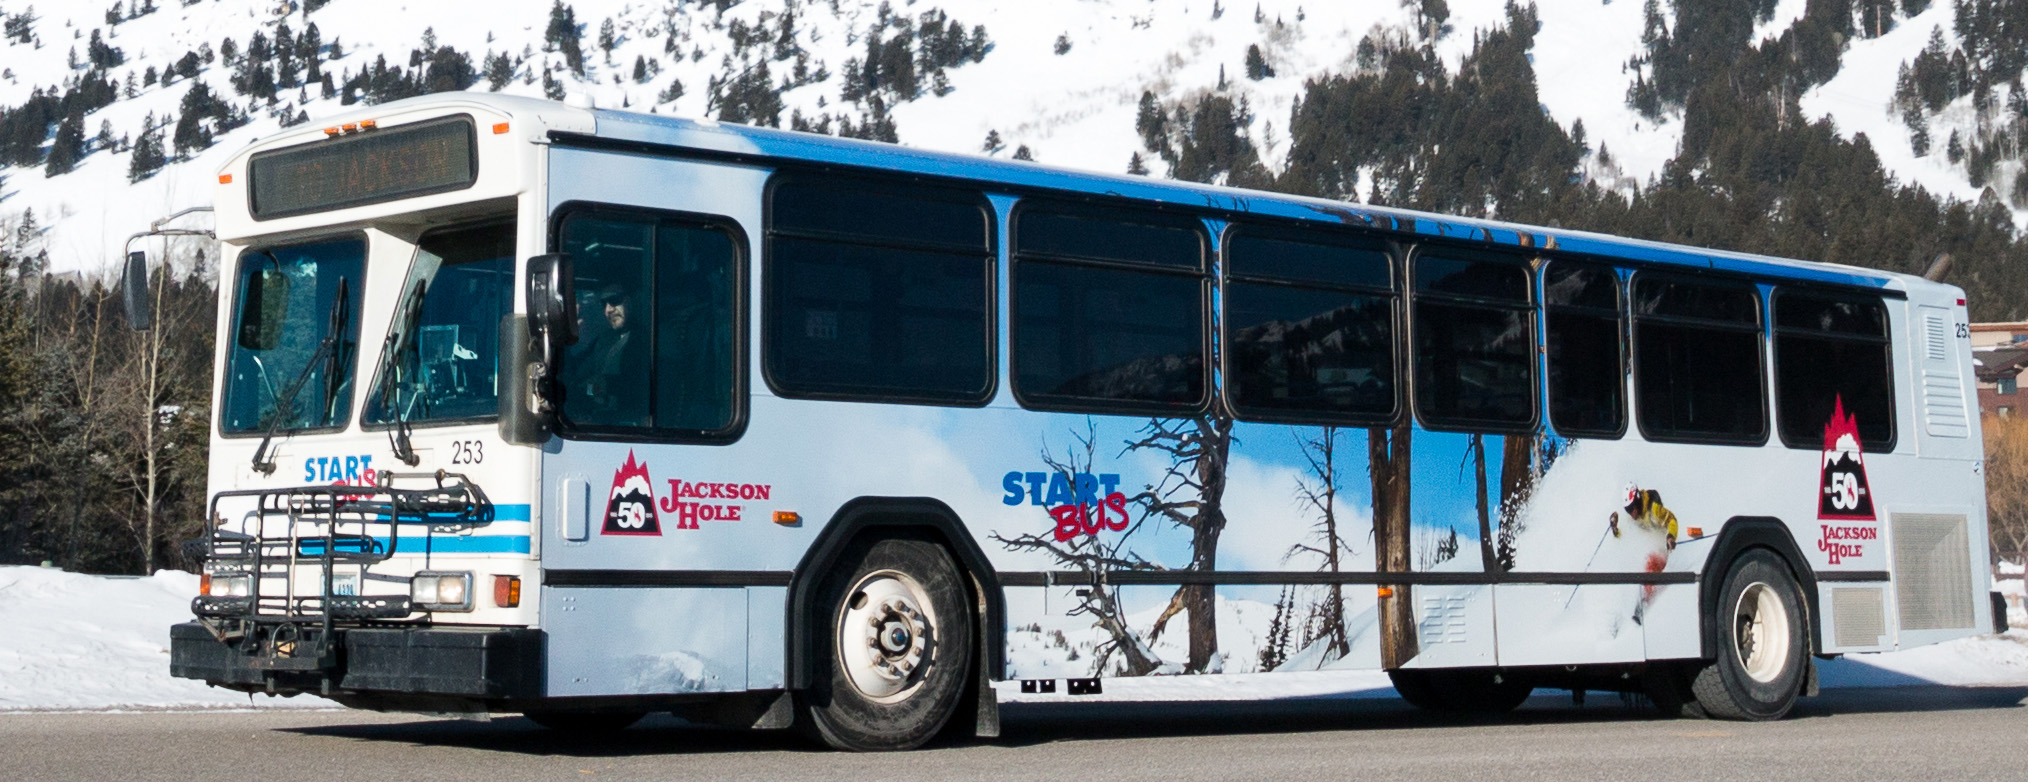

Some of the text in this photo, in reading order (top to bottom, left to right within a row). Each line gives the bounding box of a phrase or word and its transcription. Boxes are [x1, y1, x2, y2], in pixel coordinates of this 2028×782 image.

[452, 440, 484, 465] 253
[304, 454, 373, 482] START
[660, 478, 771, 513] JACKSON
[1002, 471, 1121, 506] START
[1831, 472, 1859, 510] 50
[617, 501, 646, 528] 50
[677, 502, 741, 529] HOLE
[1050, 491, 1130, 542] BUS
[1817, 524, 1877, 552] JACKSON
[1828, 543, 1863, 565] HOLE
